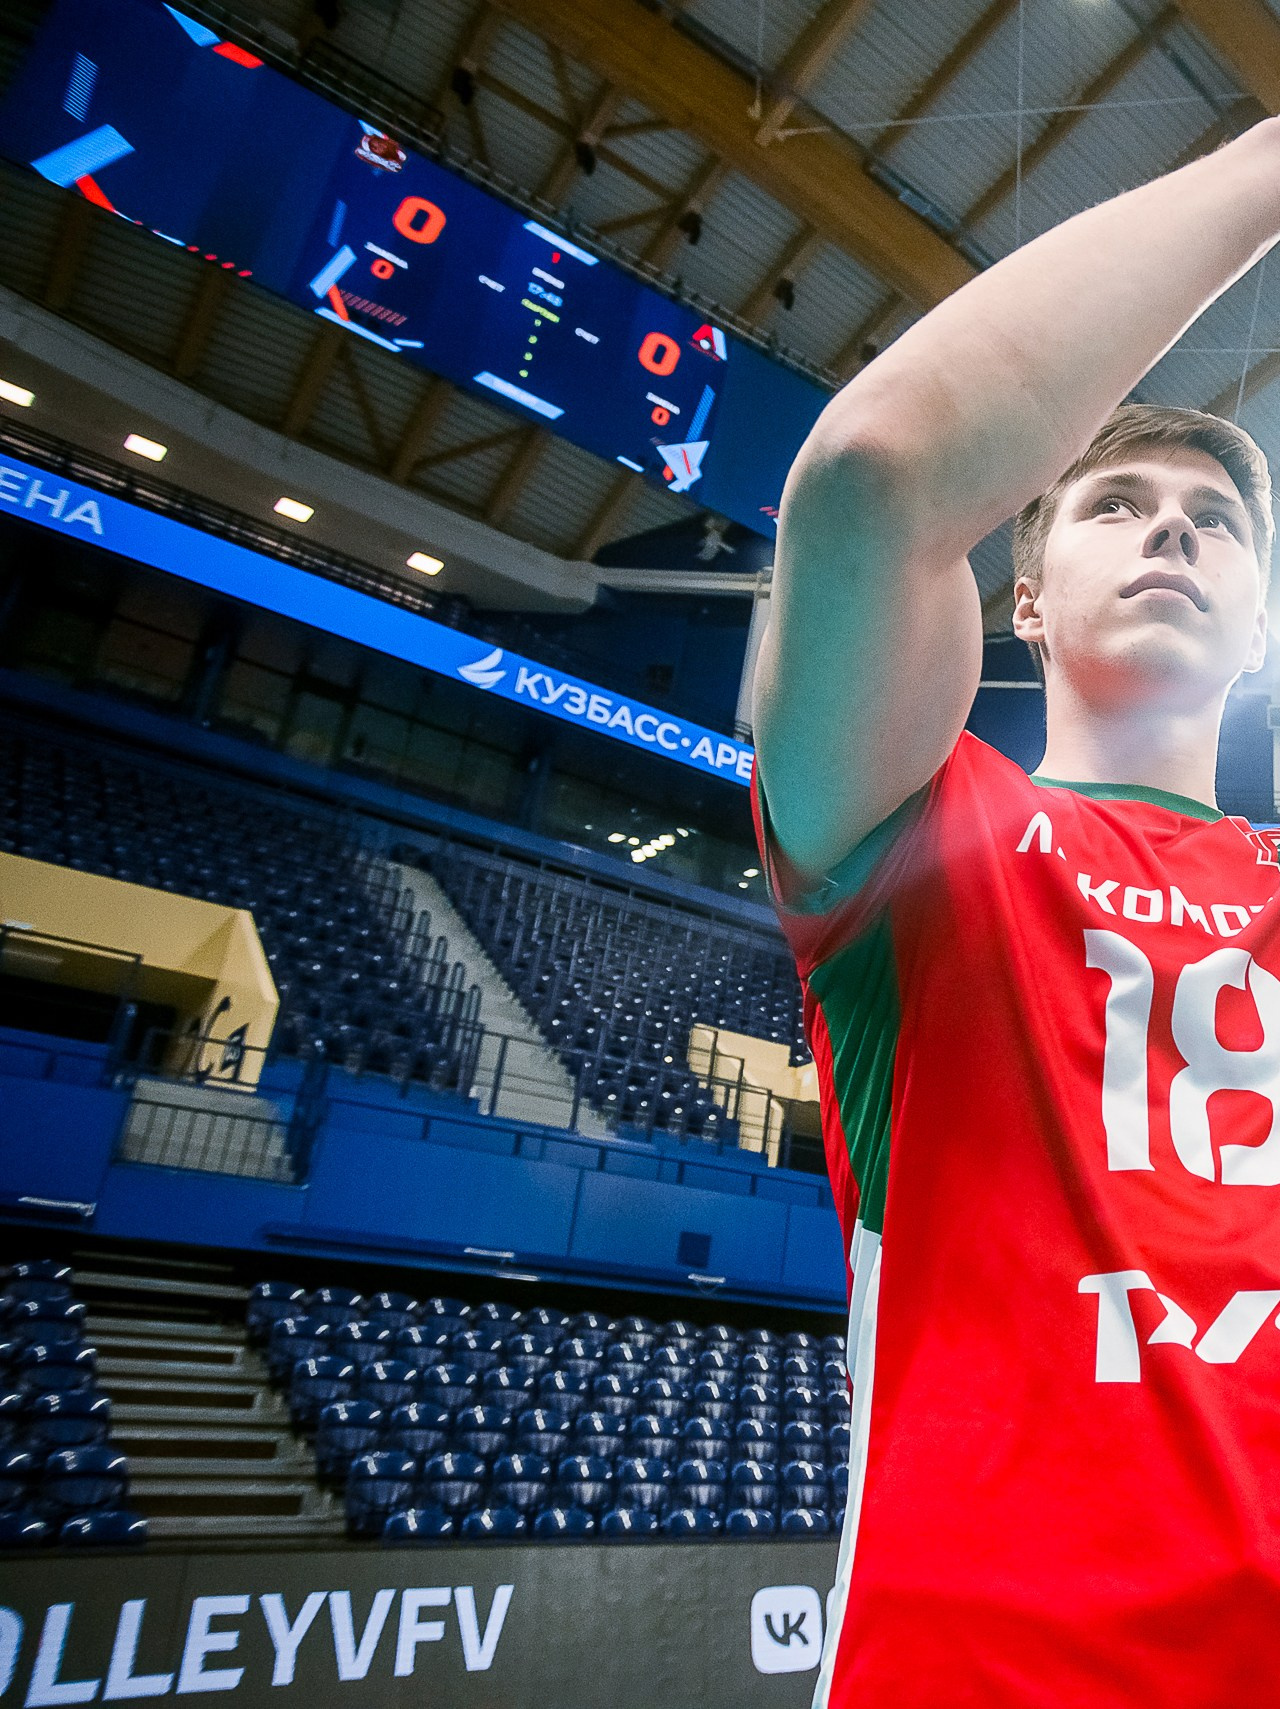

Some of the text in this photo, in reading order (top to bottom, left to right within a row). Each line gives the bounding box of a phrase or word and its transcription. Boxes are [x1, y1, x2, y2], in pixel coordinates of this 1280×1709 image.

[393, 196, 446, 244] 0
[370, 258, 395, 280] 0
[638, 332, 681, 376] 0
[651, 405, 670, 426] 0
